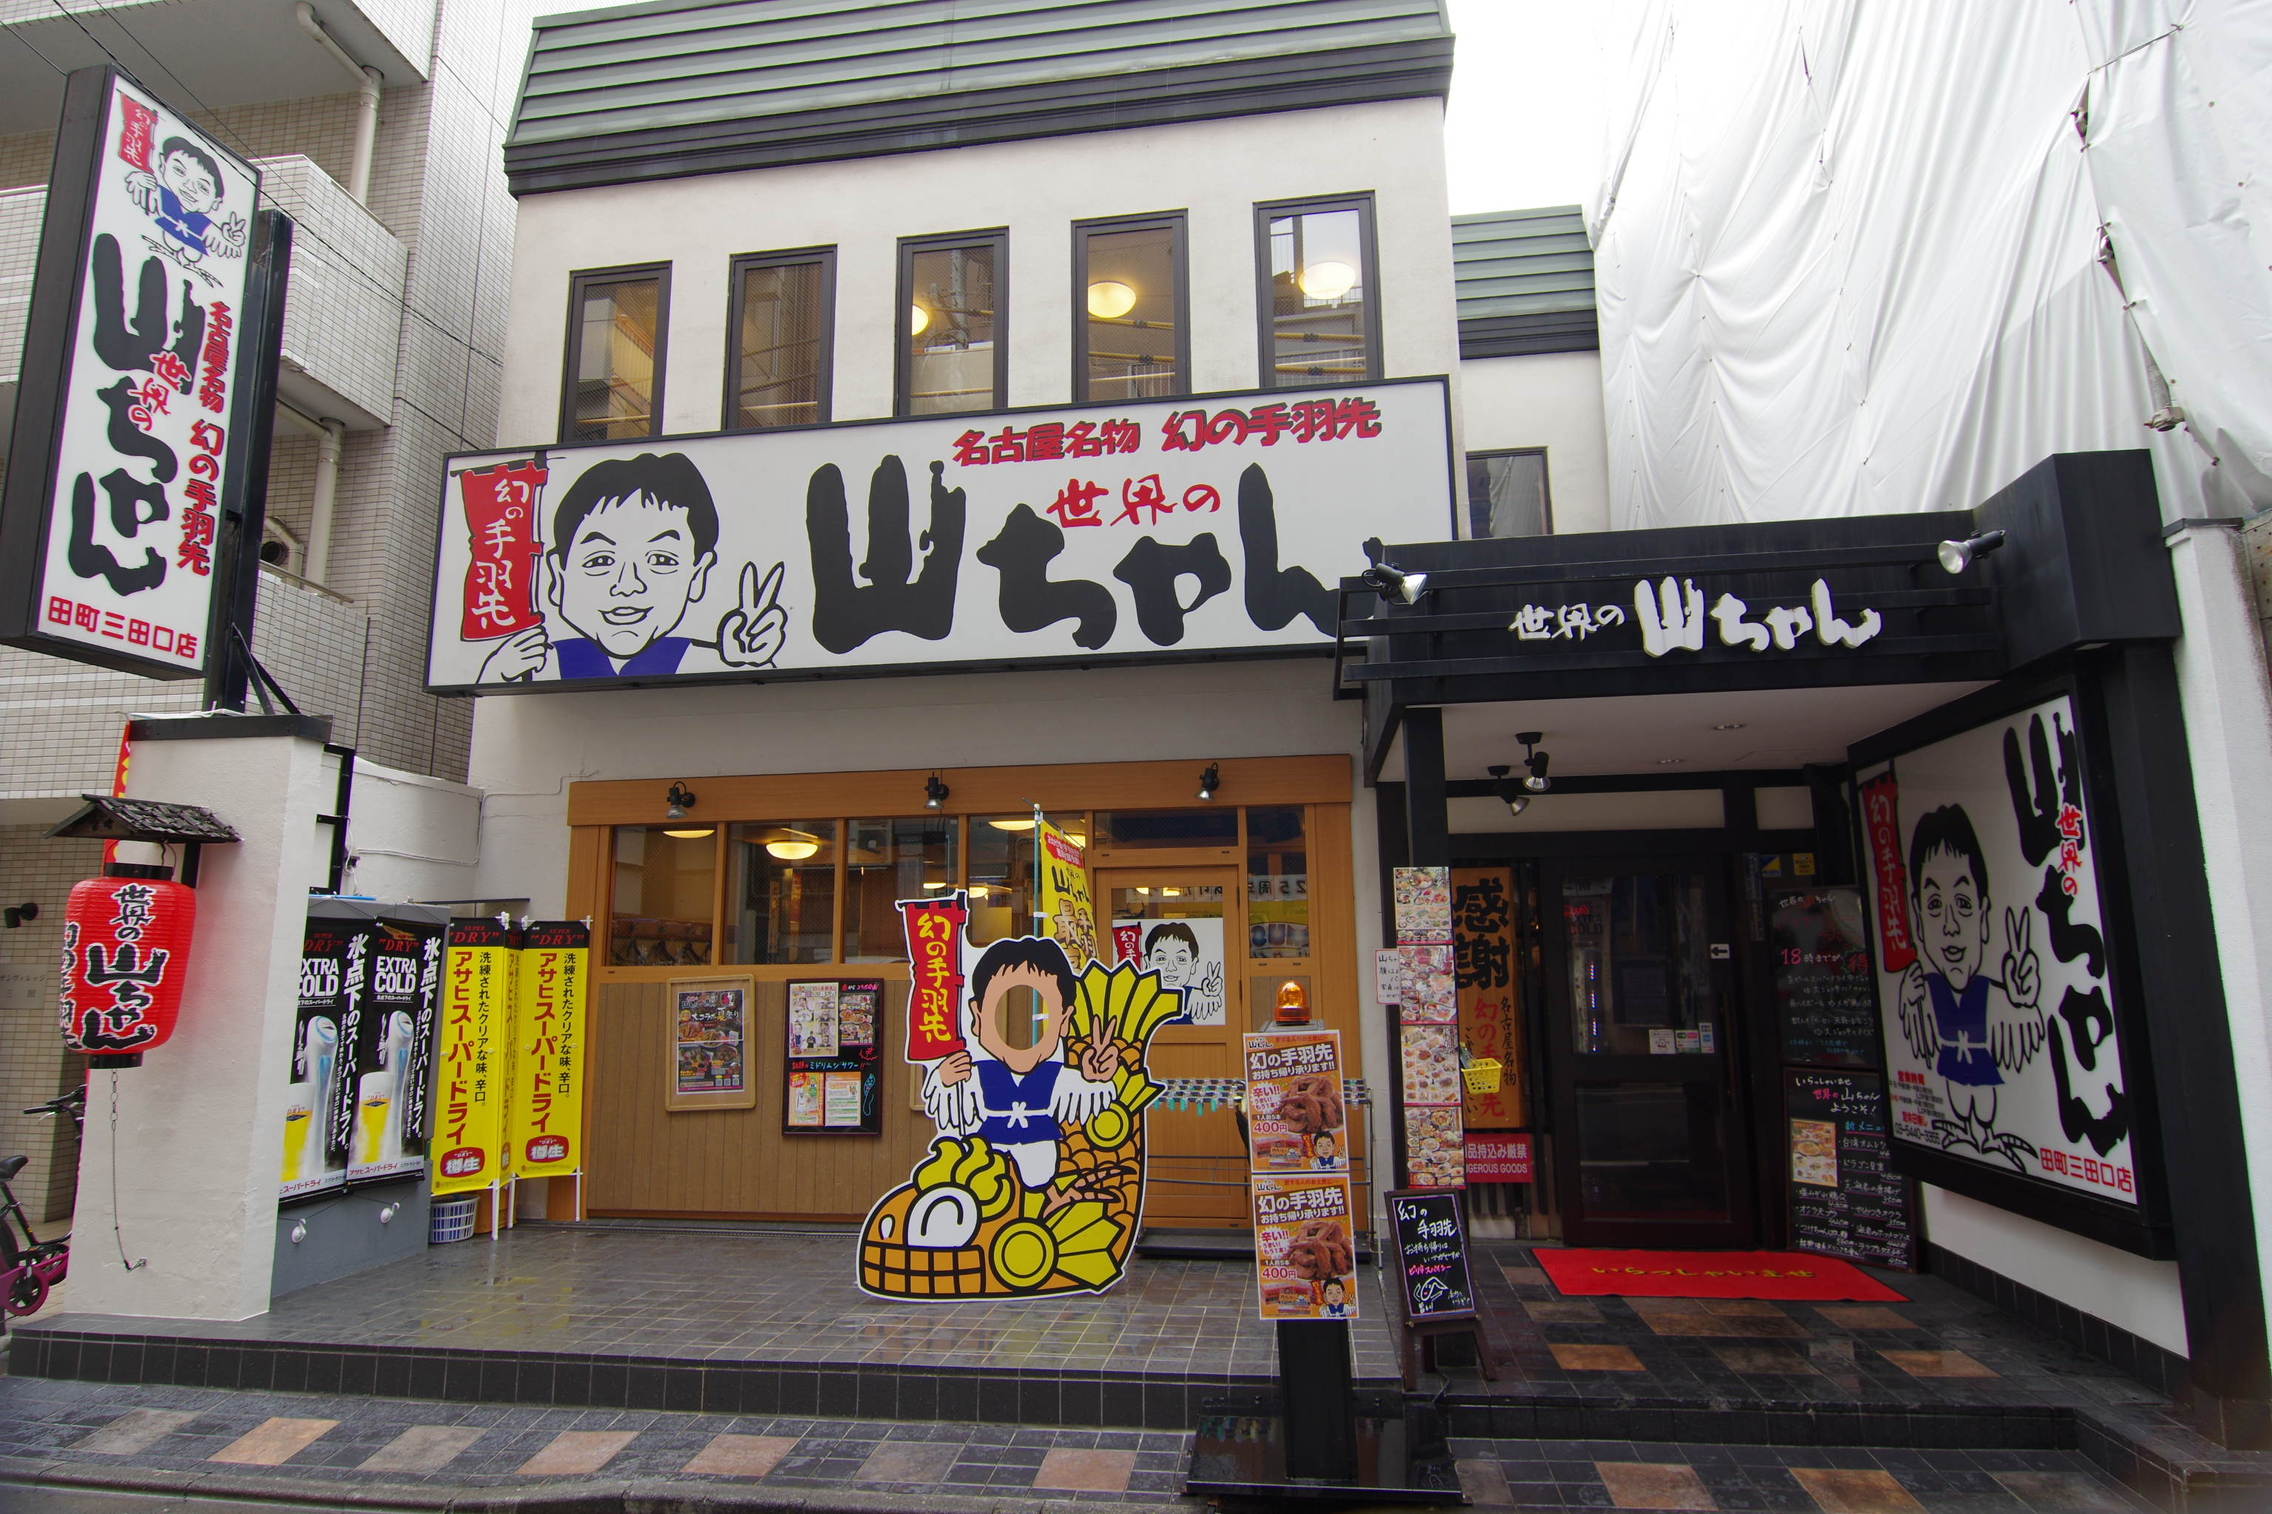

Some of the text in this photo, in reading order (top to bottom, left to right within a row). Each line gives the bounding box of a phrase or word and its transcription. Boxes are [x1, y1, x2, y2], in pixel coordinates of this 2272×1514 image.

[68, 232, 206, 598] 山ちゃん
[127, 350, 192, 432] 世界の
[952, 396, 1383, 467] 名古屋名物 幻の手羽先
[176, 300, 232, 577] 名古屋名物 幻の手羽先
[1046, 473, 1222, 528] 世界の
[471, 477, 530, 631] 幻の手羽先
[806, 454, 1386, 655] 山ちゃん
[48, 596, 197, 660] 田町三田口店
[1509, 576, 1882, 658] 世界の 山ちゃん
[1870, 792, 1908, 951] 幻の手羽先
[2056, 802, 2083, 897] 世界の
[112, 883, 157, 941] 世界の
[1453, 876, 1509, 990] 感謝
[2004, 711, 2129, 1159] 山ちゃん
[80, 942, 171, 1051] 山ちゃん
[299, 974, 339, 997] OLD
[300, 958, 339, 975] XTRA
[374, 972, 416, 994] COLD
[376, 955, 417, 974] EXTRA
[917, 912, 952, 1043] 幻の手羽先
[447, 951, 475, 1146] アサヒスーパードライ
[474, 951, 492, 1106] 洗練されたクリアな味、辛口。
[531, 952, 558, 1134] アサヒスーパードライ
[558, 952, 577, 1098] 洗練されたクリアな味、辛口。
[1250, 1043, 1334, 1070] 幻の手羽先
[1254, 1121, 1288, 1133] 400円
[1259, 1188, 1343, 1214] 幻の手羽先
[1501, 1163, 1528, 1174] GOODS
[2040, 1147, 2133, 1193] 田町三田口店
[1417, 1218, 1458, 1239] 手羽先
[1262, 1267, 1297, 1279] 400円
